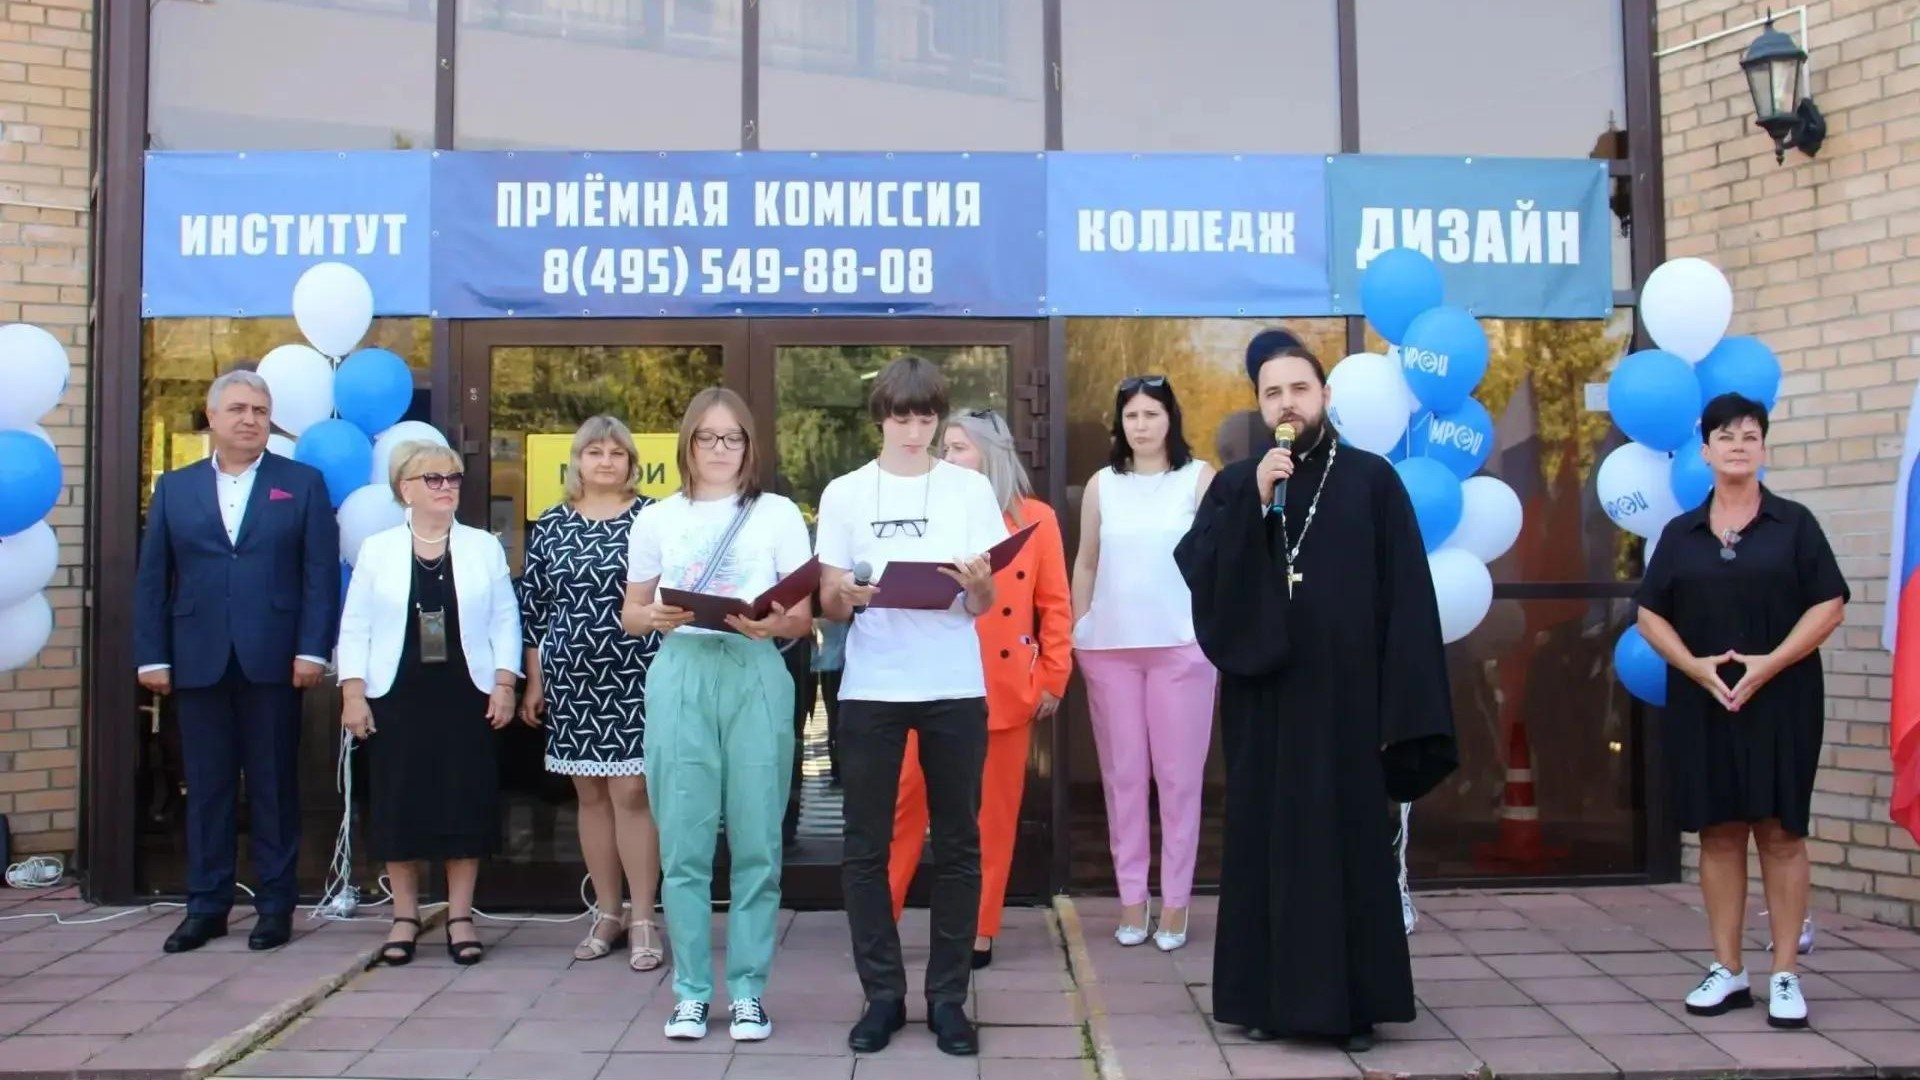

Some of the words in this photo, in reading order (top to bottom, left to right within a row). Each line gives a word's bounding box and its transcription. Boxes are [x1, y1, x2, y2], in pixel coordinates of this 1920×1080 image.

[497, 173, 728, 227] ПРИЁМНАЯ
[755, 181, 981, 227] КОМИССИЯ
[180, 213, 407, 256] ИНСТИТУТ
[1078, 209, 1296, 254] КОЛЛЕДЖ
[1356, 199, 1580, 269] ДИЗАЙН
[543, 246, 689, 296] 8(495)
[701, 248, 934, 294] 549-88-08
